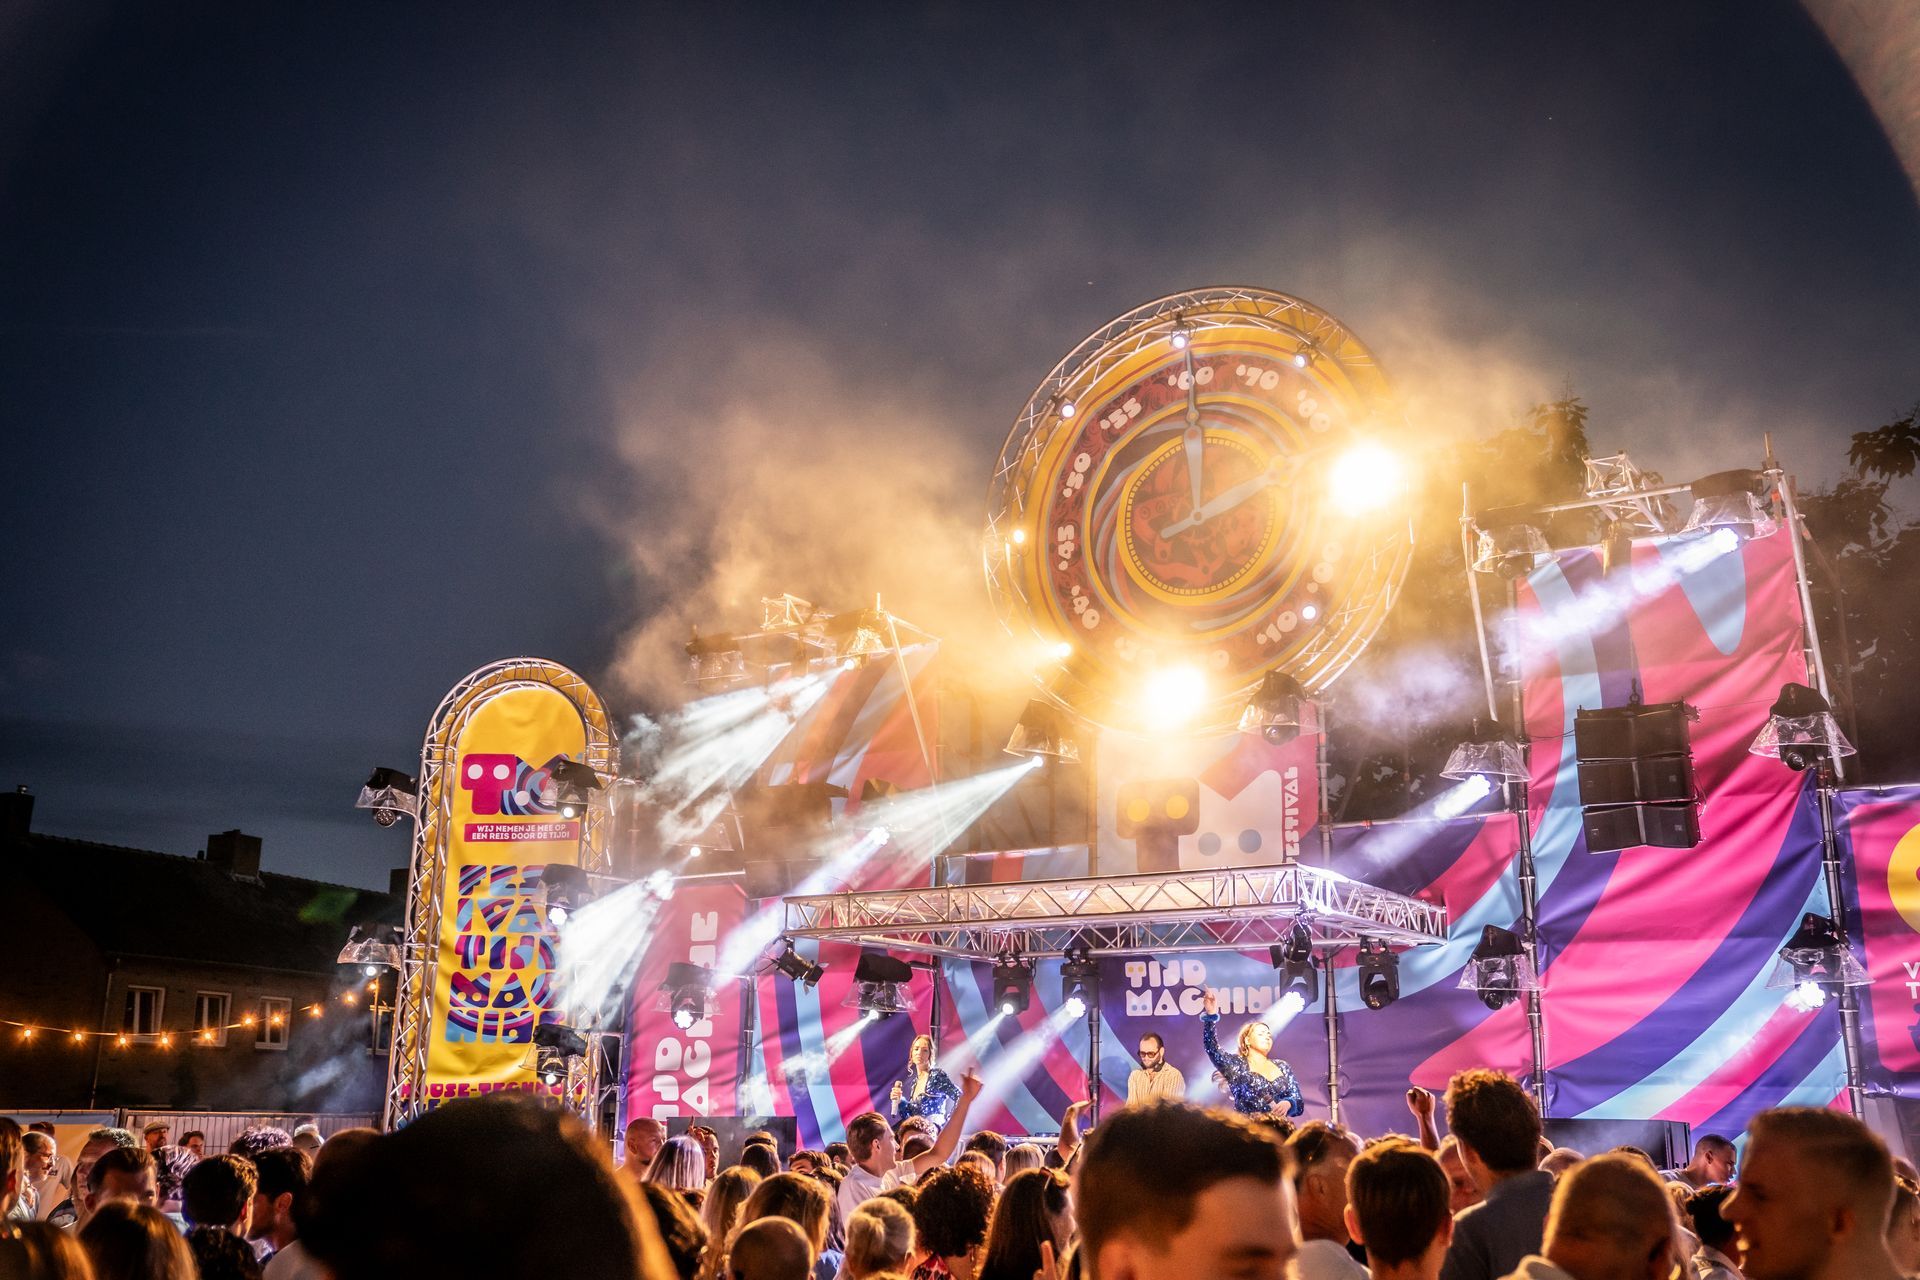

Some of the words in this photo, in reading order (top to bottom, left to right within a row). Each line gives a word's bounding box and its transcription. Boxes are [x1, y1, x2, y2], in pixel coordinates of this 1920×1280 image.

[1168, 366, 1214, 390] '60
[1236, 364, 1279, 390] '70
[1100, 397, 1141, 430] '55
[1063, 452, 1091, 498] '50
[1057, 524, 1074, 571] '45
[1071, 585, 1100, 630] '40
[1256, 610, 1298, 645] '10
[472, 832, 488, 840] EEN
[489, 832, 510, 840] REIS
[537, 831, 548, 839] DE
[549, 831, 570, 839] TIJD!
[477, 825, 494, 833] WIJ
[537, 824, 553, 832] MEE
[459, 865, 545, 897] FES
[456, 898, 559, 933] IVA
[1125, 959, 1206, 988] TIJD
[652, 1037, 683, 1122] IJD
